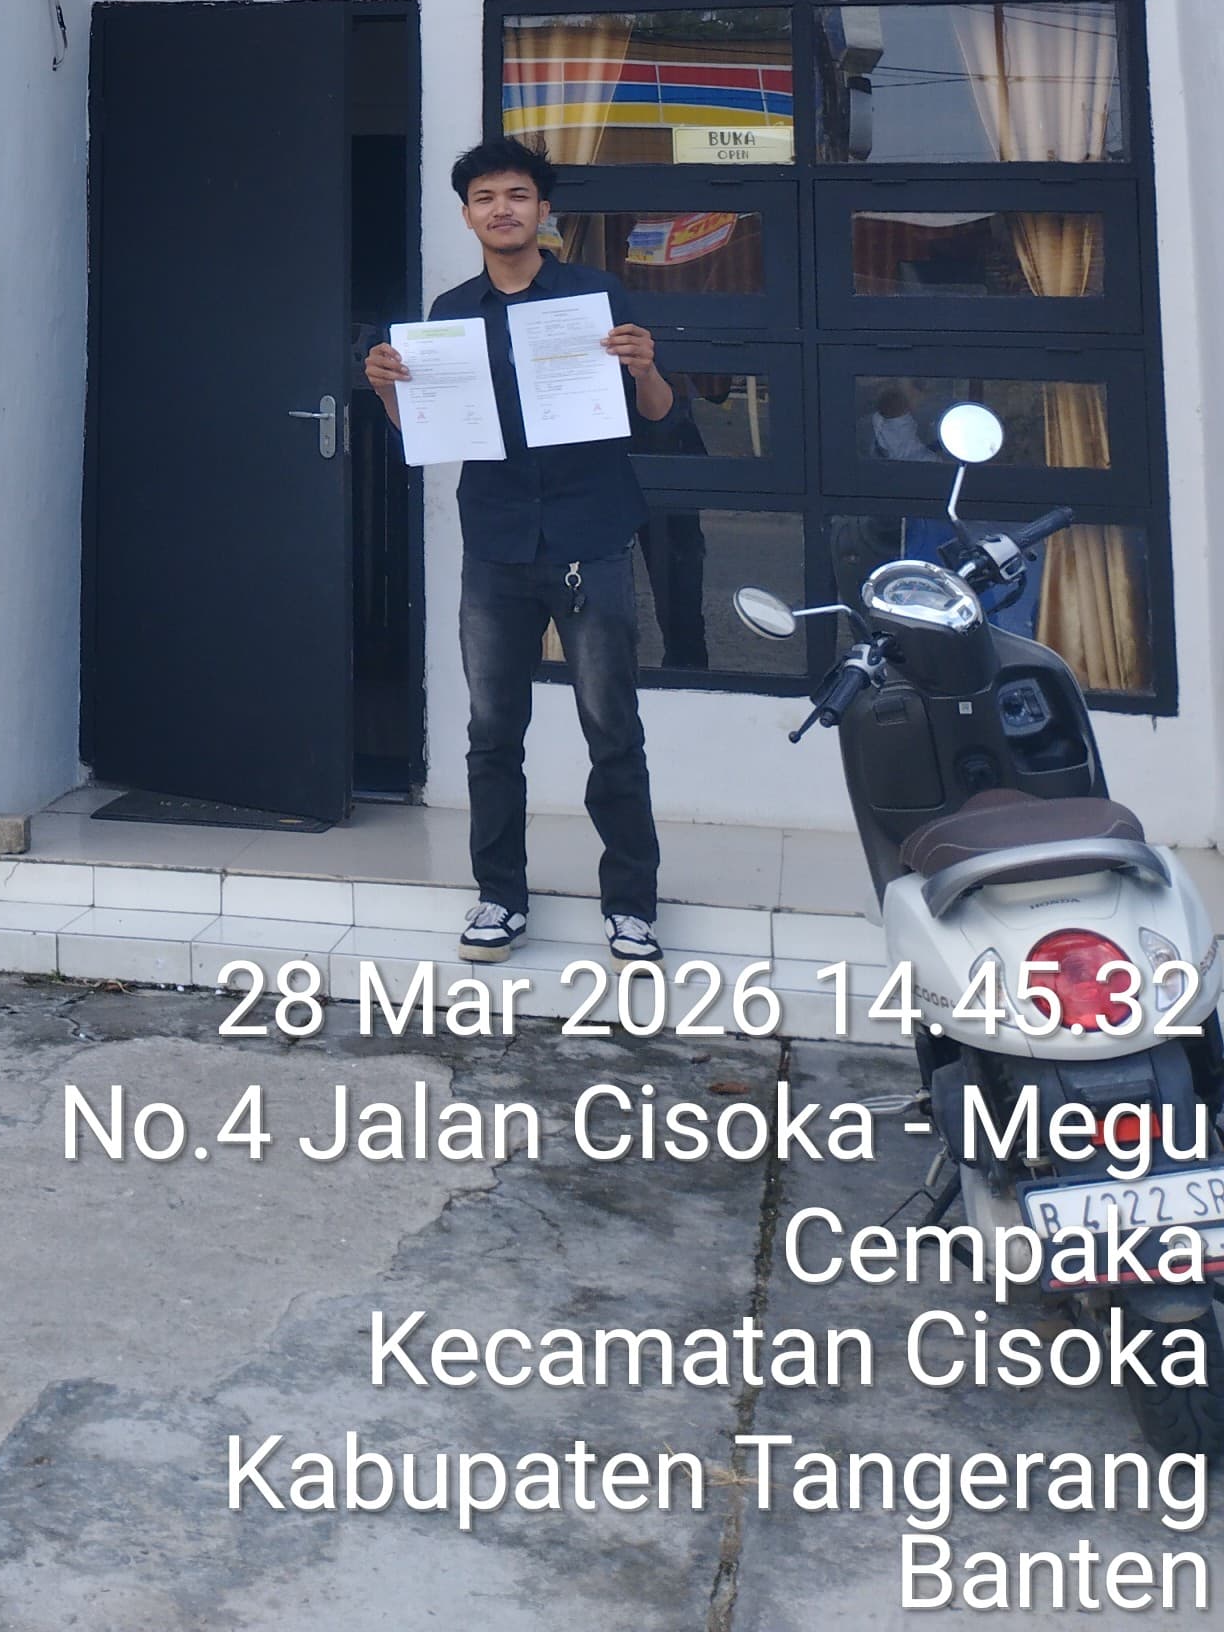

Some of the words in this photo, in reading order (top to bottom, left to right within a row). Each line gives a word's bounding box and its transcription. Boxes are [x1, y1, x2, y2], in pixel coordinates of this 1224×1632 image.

[708, 130, 756, 146] BUKA
[717, 150, 749, 160] OPEN
[1040, 1203, 1061, 1238] B
